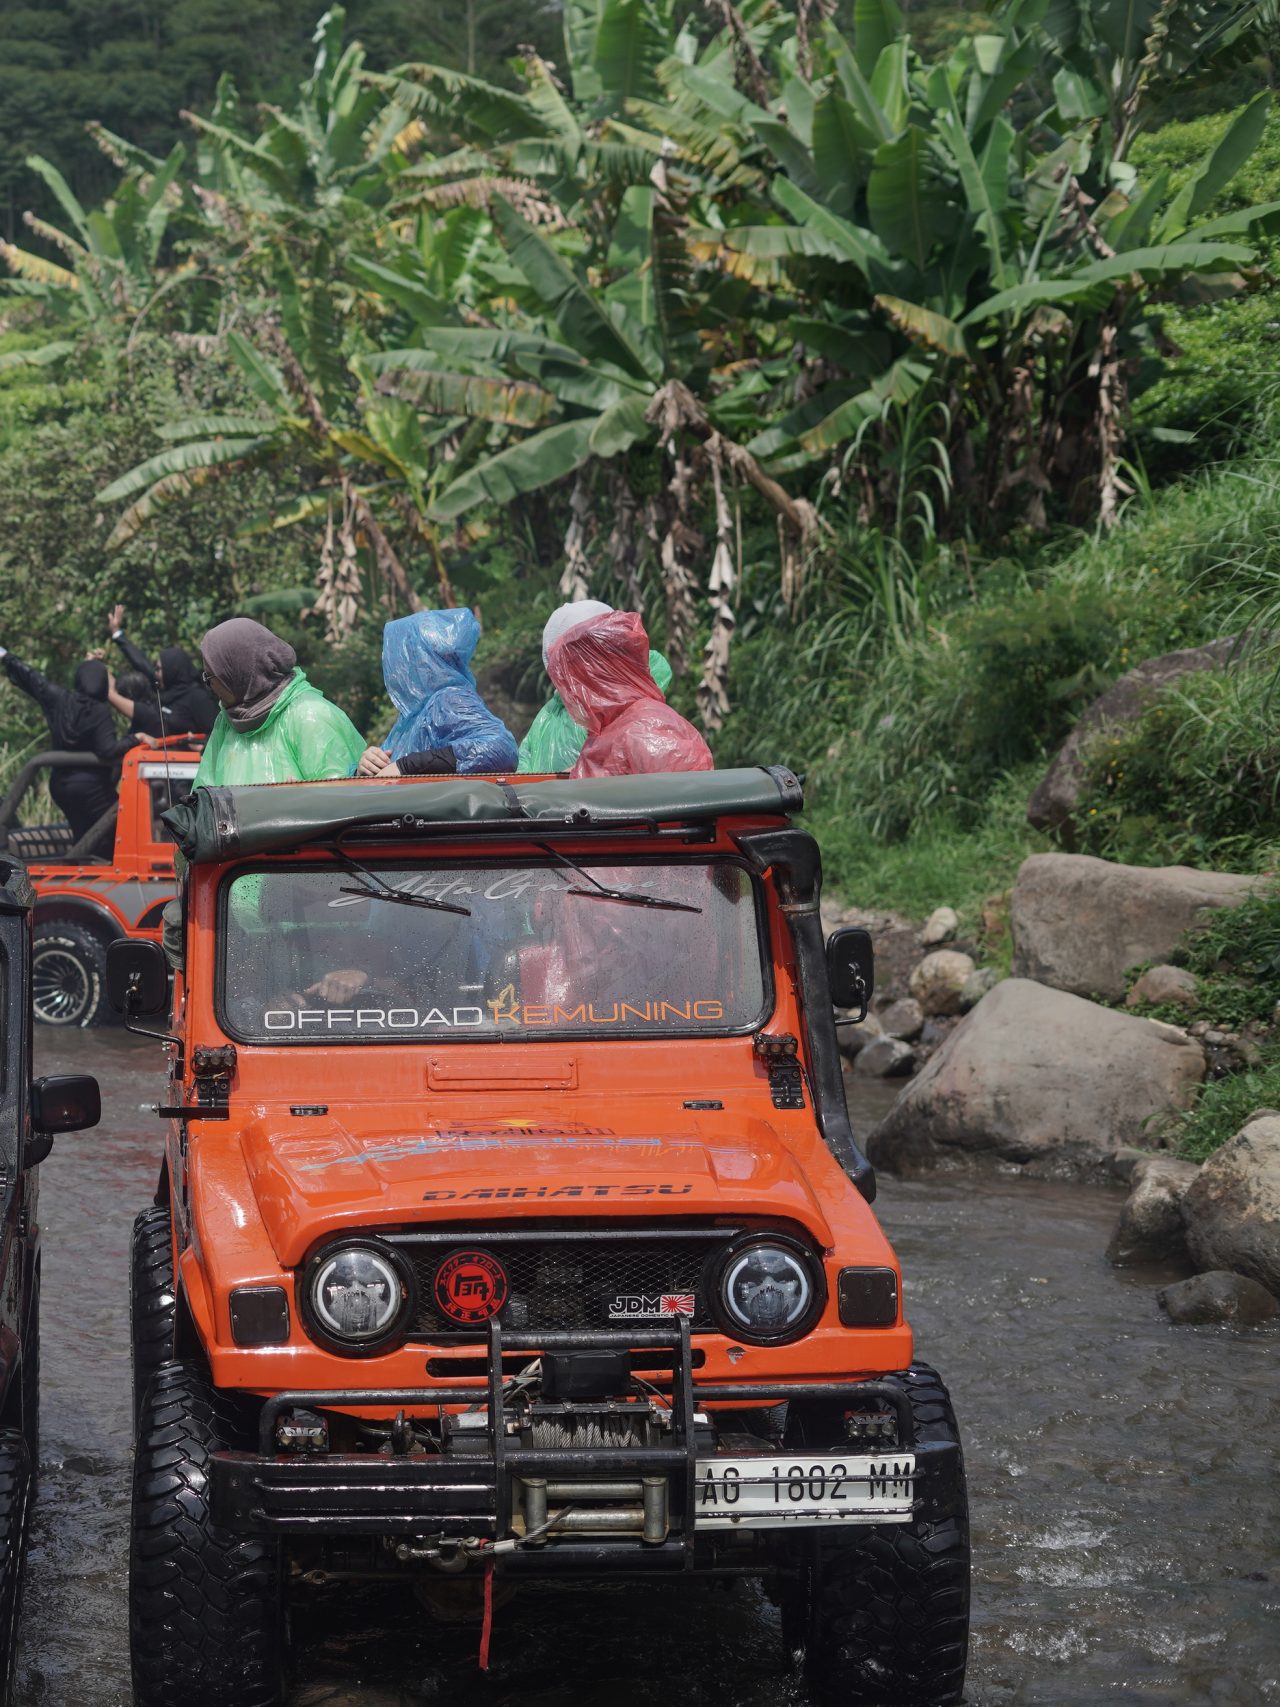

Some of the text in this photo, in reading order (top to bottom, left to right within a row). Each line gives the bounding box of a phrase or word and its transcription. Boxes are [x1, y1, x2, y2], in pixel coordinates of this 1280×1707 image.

[264, 1000, 722, 1030] OFFROAD KEMUNING
[422, 1184, 693, 1201] DAIHATSU
[609, 1295, 660, 1314] JDM
[702, 1462, 910, 1505] AG 1802 MM
